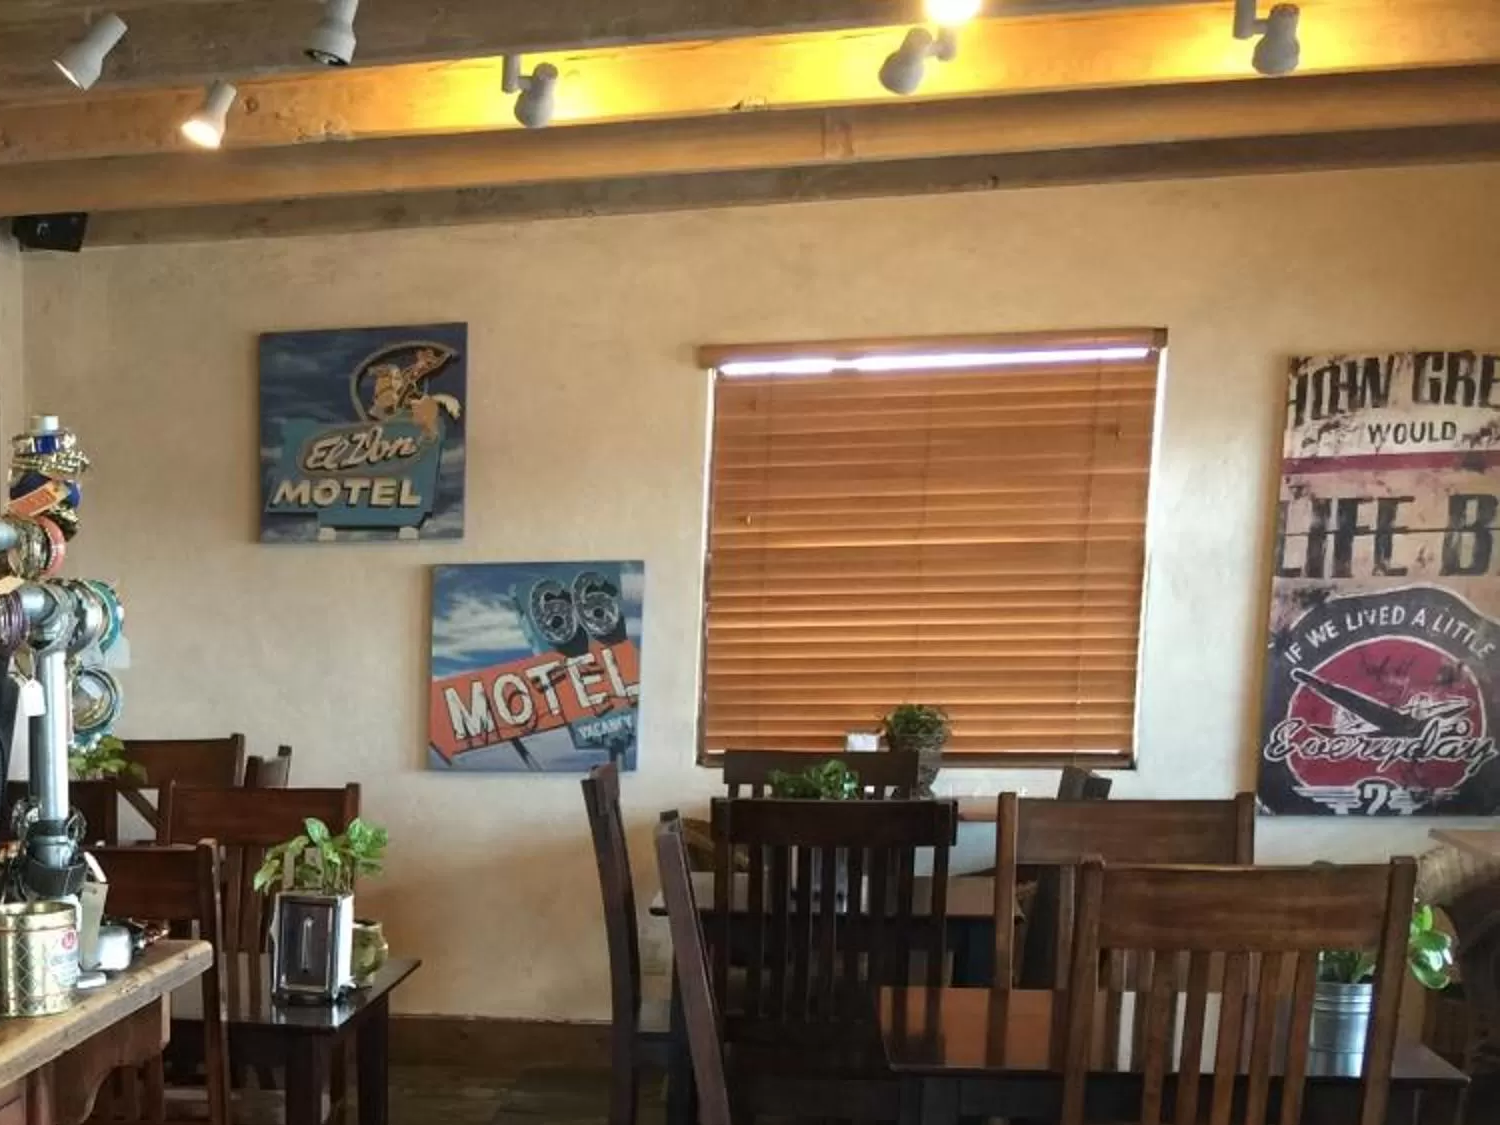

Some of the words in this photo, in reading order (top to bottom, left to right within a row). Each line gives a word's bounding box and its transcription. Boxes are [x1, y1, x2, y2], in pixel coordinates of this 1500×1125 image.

[306, 434, 342, 470] El
[342, 425, 417, 467] Don
[1368, 421, 1457, 445] WOULD
[270, 478, 422, 508] MOTEL
[1275, 496, 1415, 578] LIFE
[528, 570, 620, 644] 66
[1284, 642, 1303, 664] IF
[1305, 619, 1340, 648] WE
[1345, 605, 1405, 632] LIVED
[1410, 608, 1426, 627] A
[1431, 613, 1496, 659] LITTLE
[444, 648, 640, 739] MOTEL
[1264, 716, 1499, 778] Everyday
